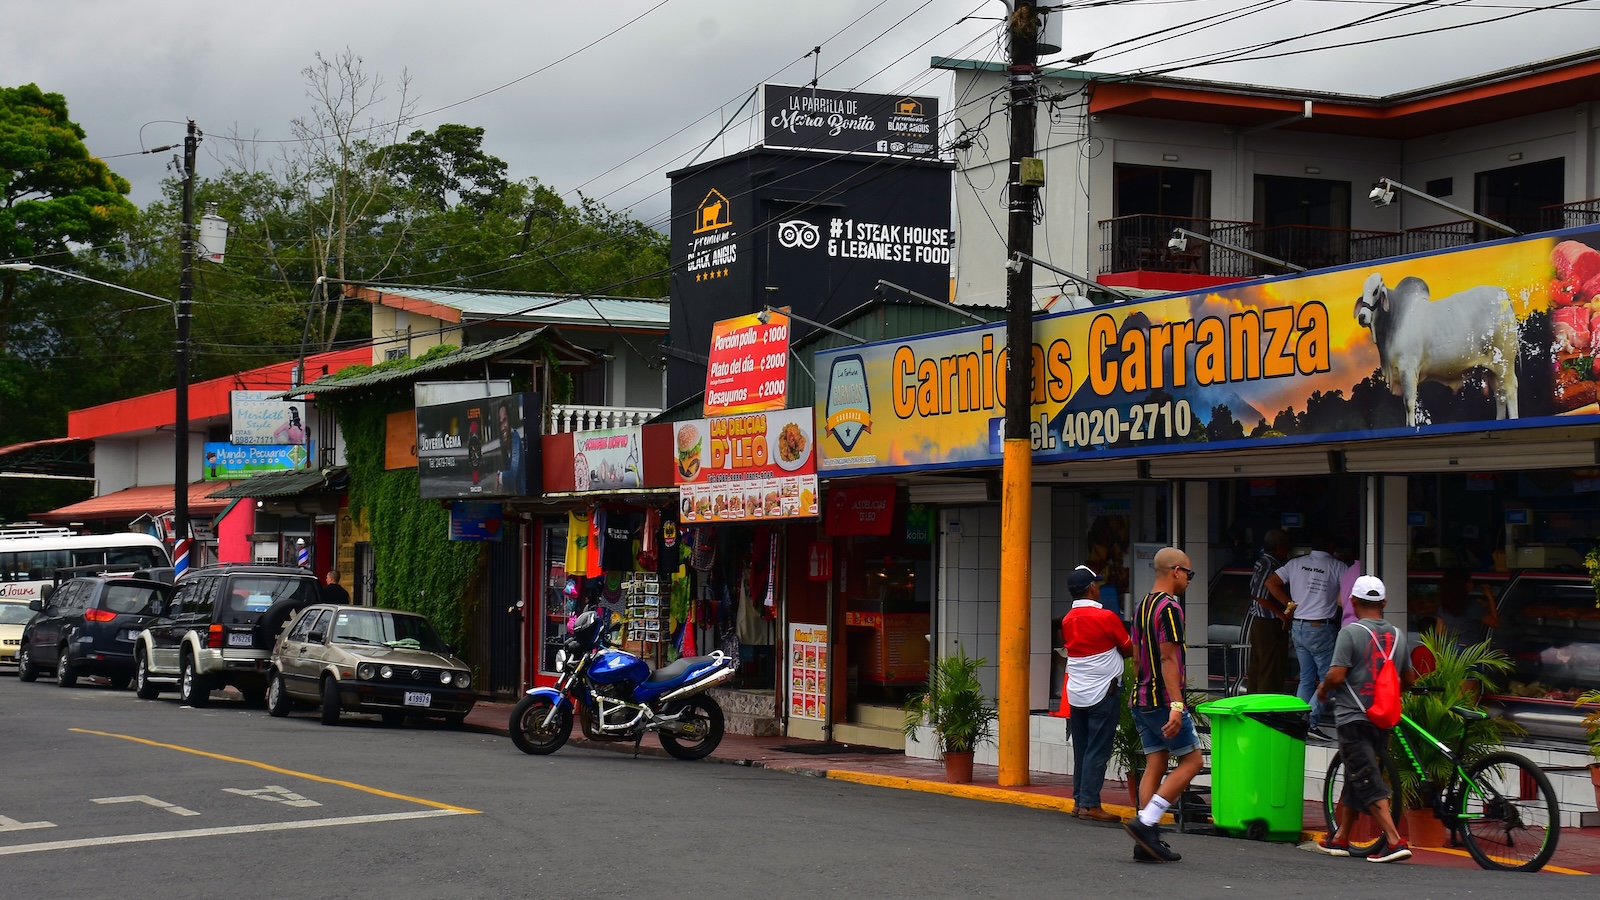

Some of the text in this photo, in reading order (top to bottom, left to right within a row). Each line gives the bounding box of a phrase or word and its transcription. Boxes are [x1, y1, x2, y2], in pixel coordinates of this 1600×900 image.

[790, 96, 858, 115] LA PARRILLA DE
[887, 122, 930, 133] BLACK ANGUS
[693, 229, 730, 252] premium
[830, 218, 949, 246] #1 STEAK HOUSE
[687, 244, 737, 272] BLACK ANGUS
[827, 239, 950, 265] & LEBANESE FOOD
[714, 330, 739, 351] Porción
[738, 327, 757, 350] pollo
[1088, 301, 1331, 396] Carranza
[710, 361, 729, 378] Plato
[729, 358, 741, 375] del
[741, 354, 754, 373] día
[707, 388, 748, 406] Desayunos
[237, 409, 284, 420] Meribeth
[836, 412, 861, 423] CARRANZA
[246, 420, 271, 431] Style
[711, 414, 767, 438] LAS DELICIAS
[1031, 413, 1055, 450] el.
[1062, 400, 1192, 447] 4020-2710
[235, 436, 274, 444] 8982-7171
[421, 434, 444, 451] JOYERÍA
[444, 433, 462, 448] GEMA
[216, 448, 286, 460] Mundo Pecuario
[794, 627, 813, 643] Menú
